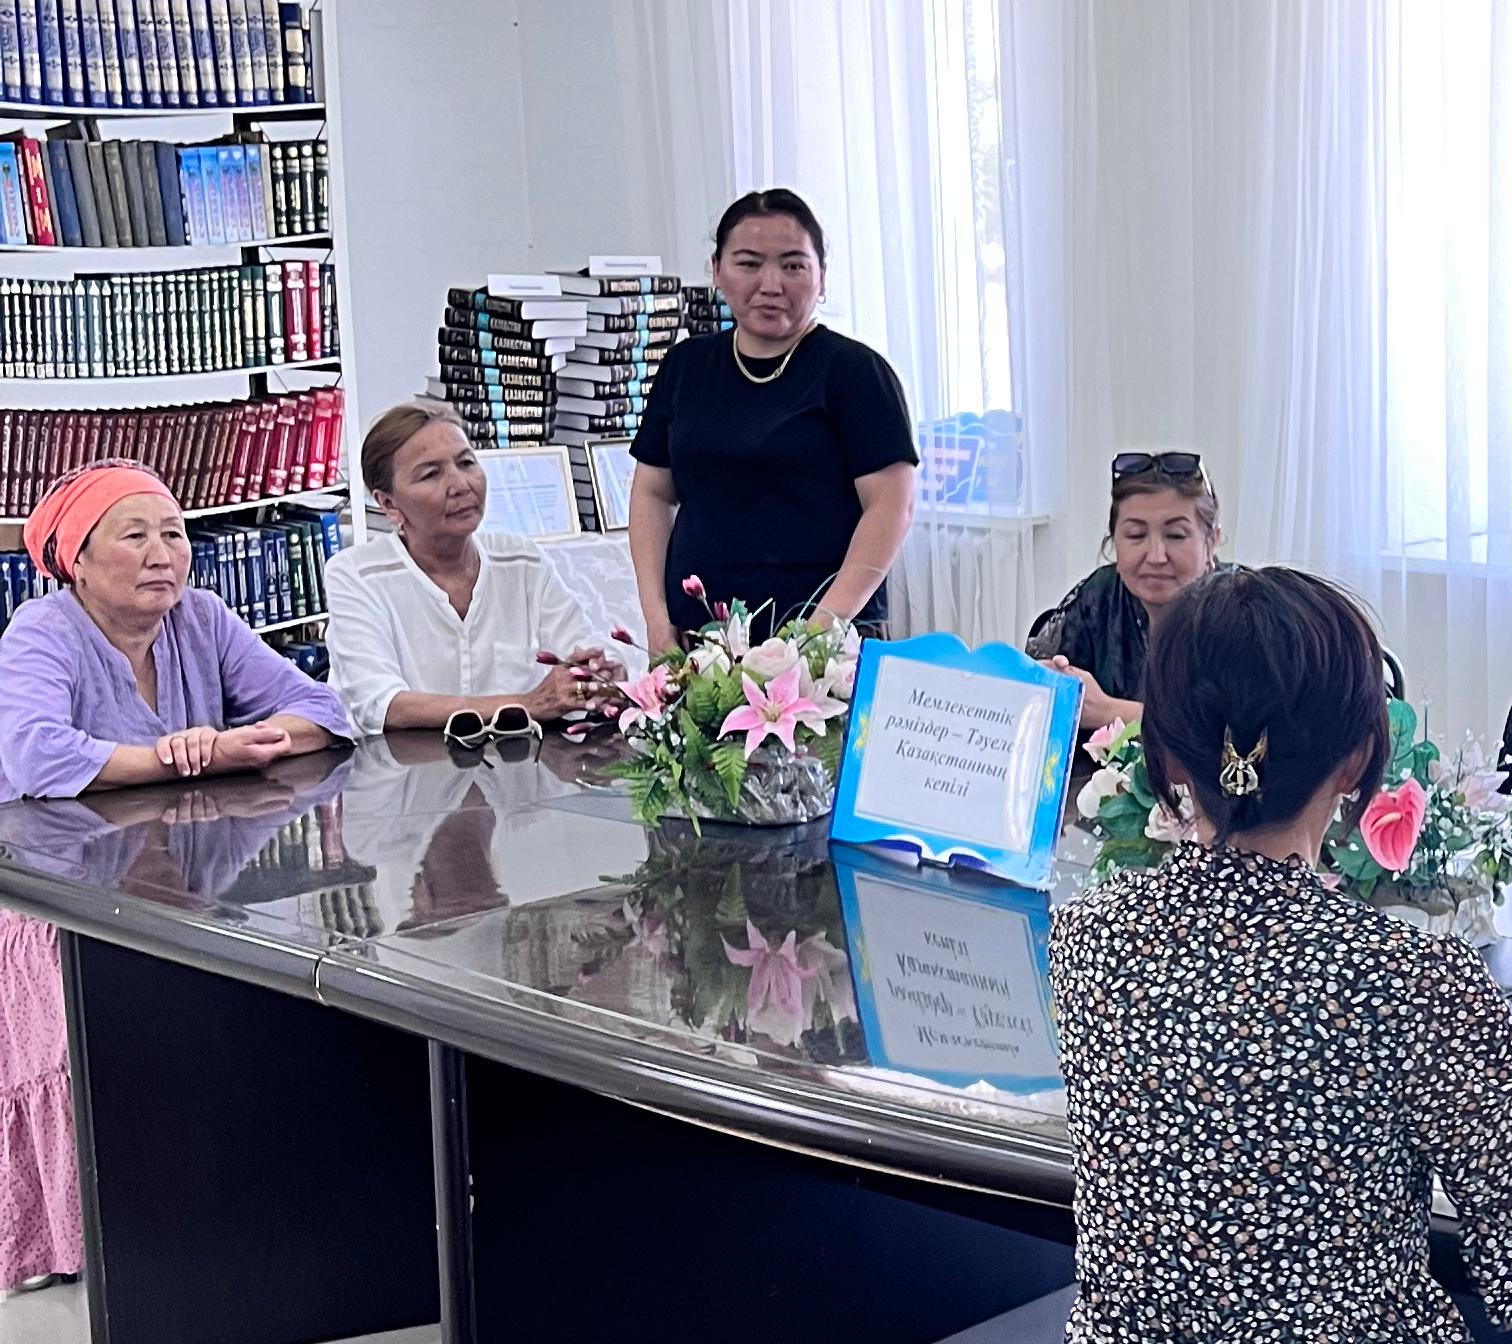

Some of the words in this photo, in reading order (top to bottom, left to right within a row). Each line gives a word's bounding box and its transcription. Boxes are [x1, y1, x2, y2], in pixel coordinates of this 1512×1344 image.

[908, 688, 1015, 726] Мемлекеттік
[884, 715, 949, 742] рәміздер
[896, 738, 1008, 783] Қазақстанның
[924, 777, 970, 797] кепілі
